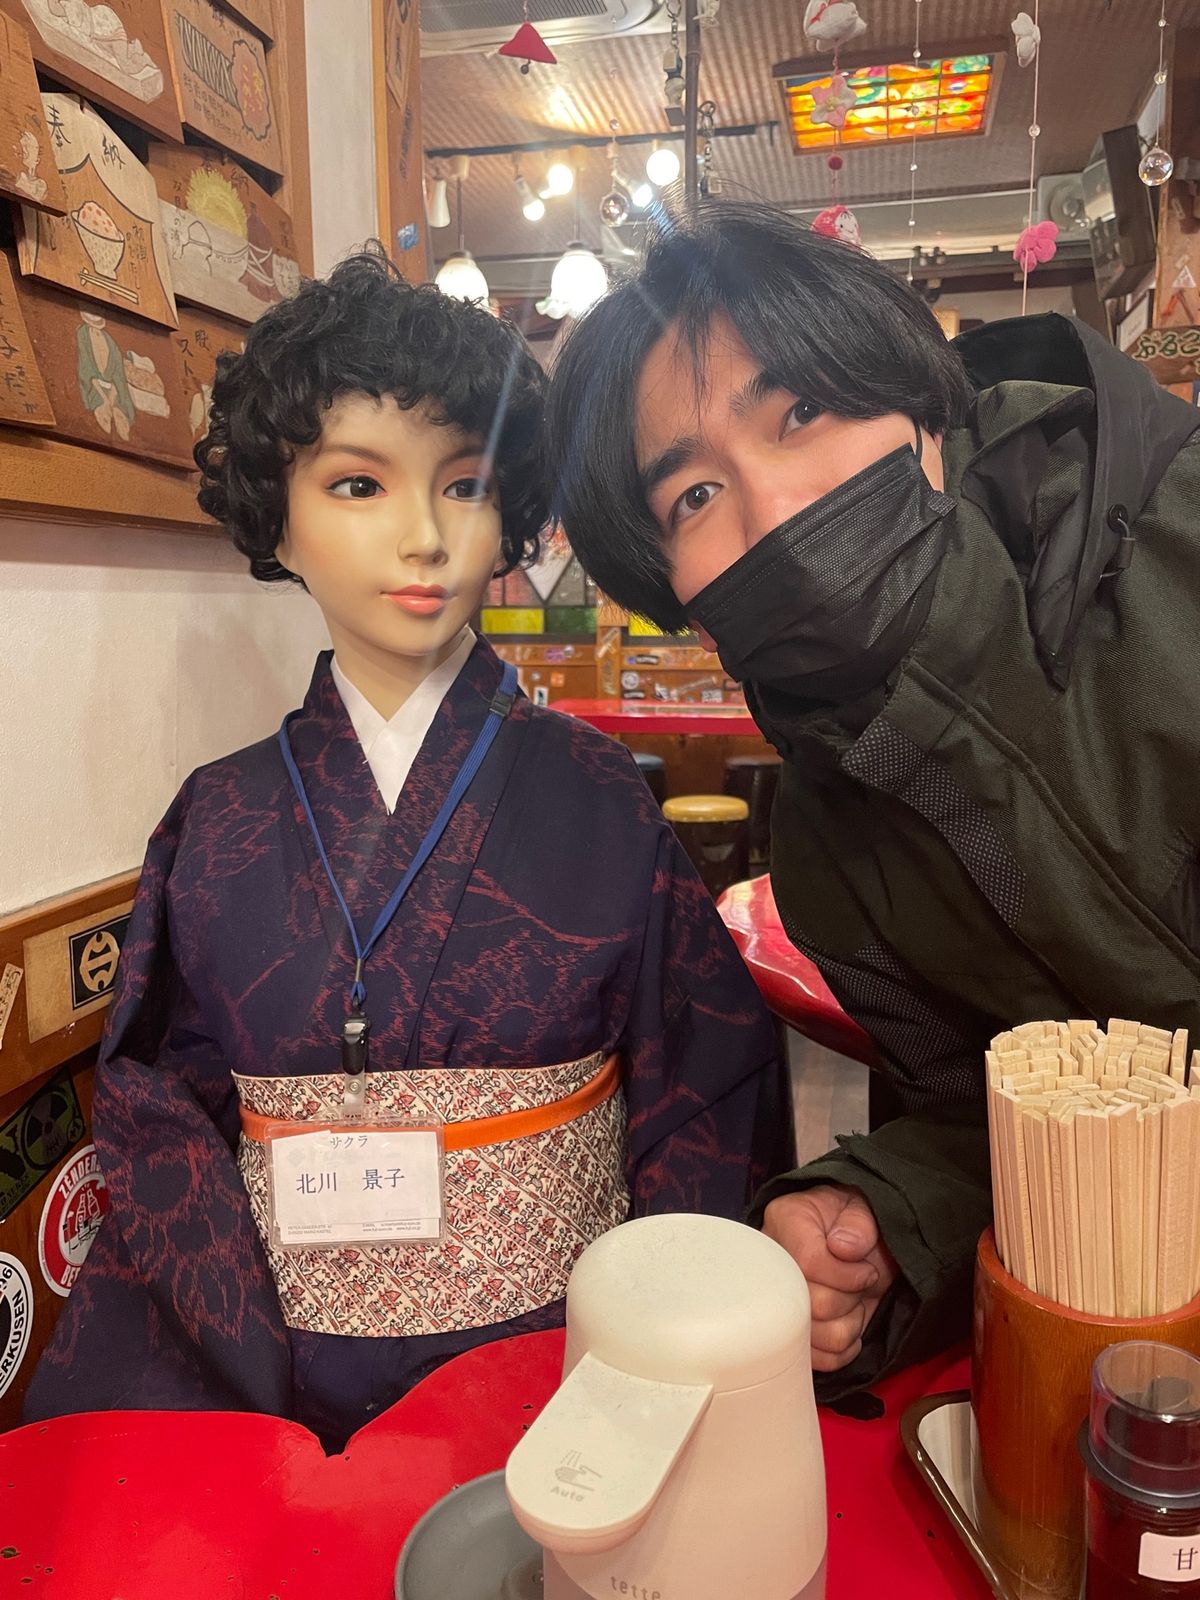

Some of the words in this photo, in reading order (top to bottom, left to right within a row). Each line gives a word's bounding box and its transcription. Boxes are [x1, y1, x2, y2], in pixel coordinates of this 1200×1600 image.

[330, 1134, 368, 1149] サクラ
[296, 1171, 338, 1195] 北川
[362, 1168, 406, 1191] 景子
[549, 1485, 586, 1502] Auto
[611, 1575, 662, 1600] tette
